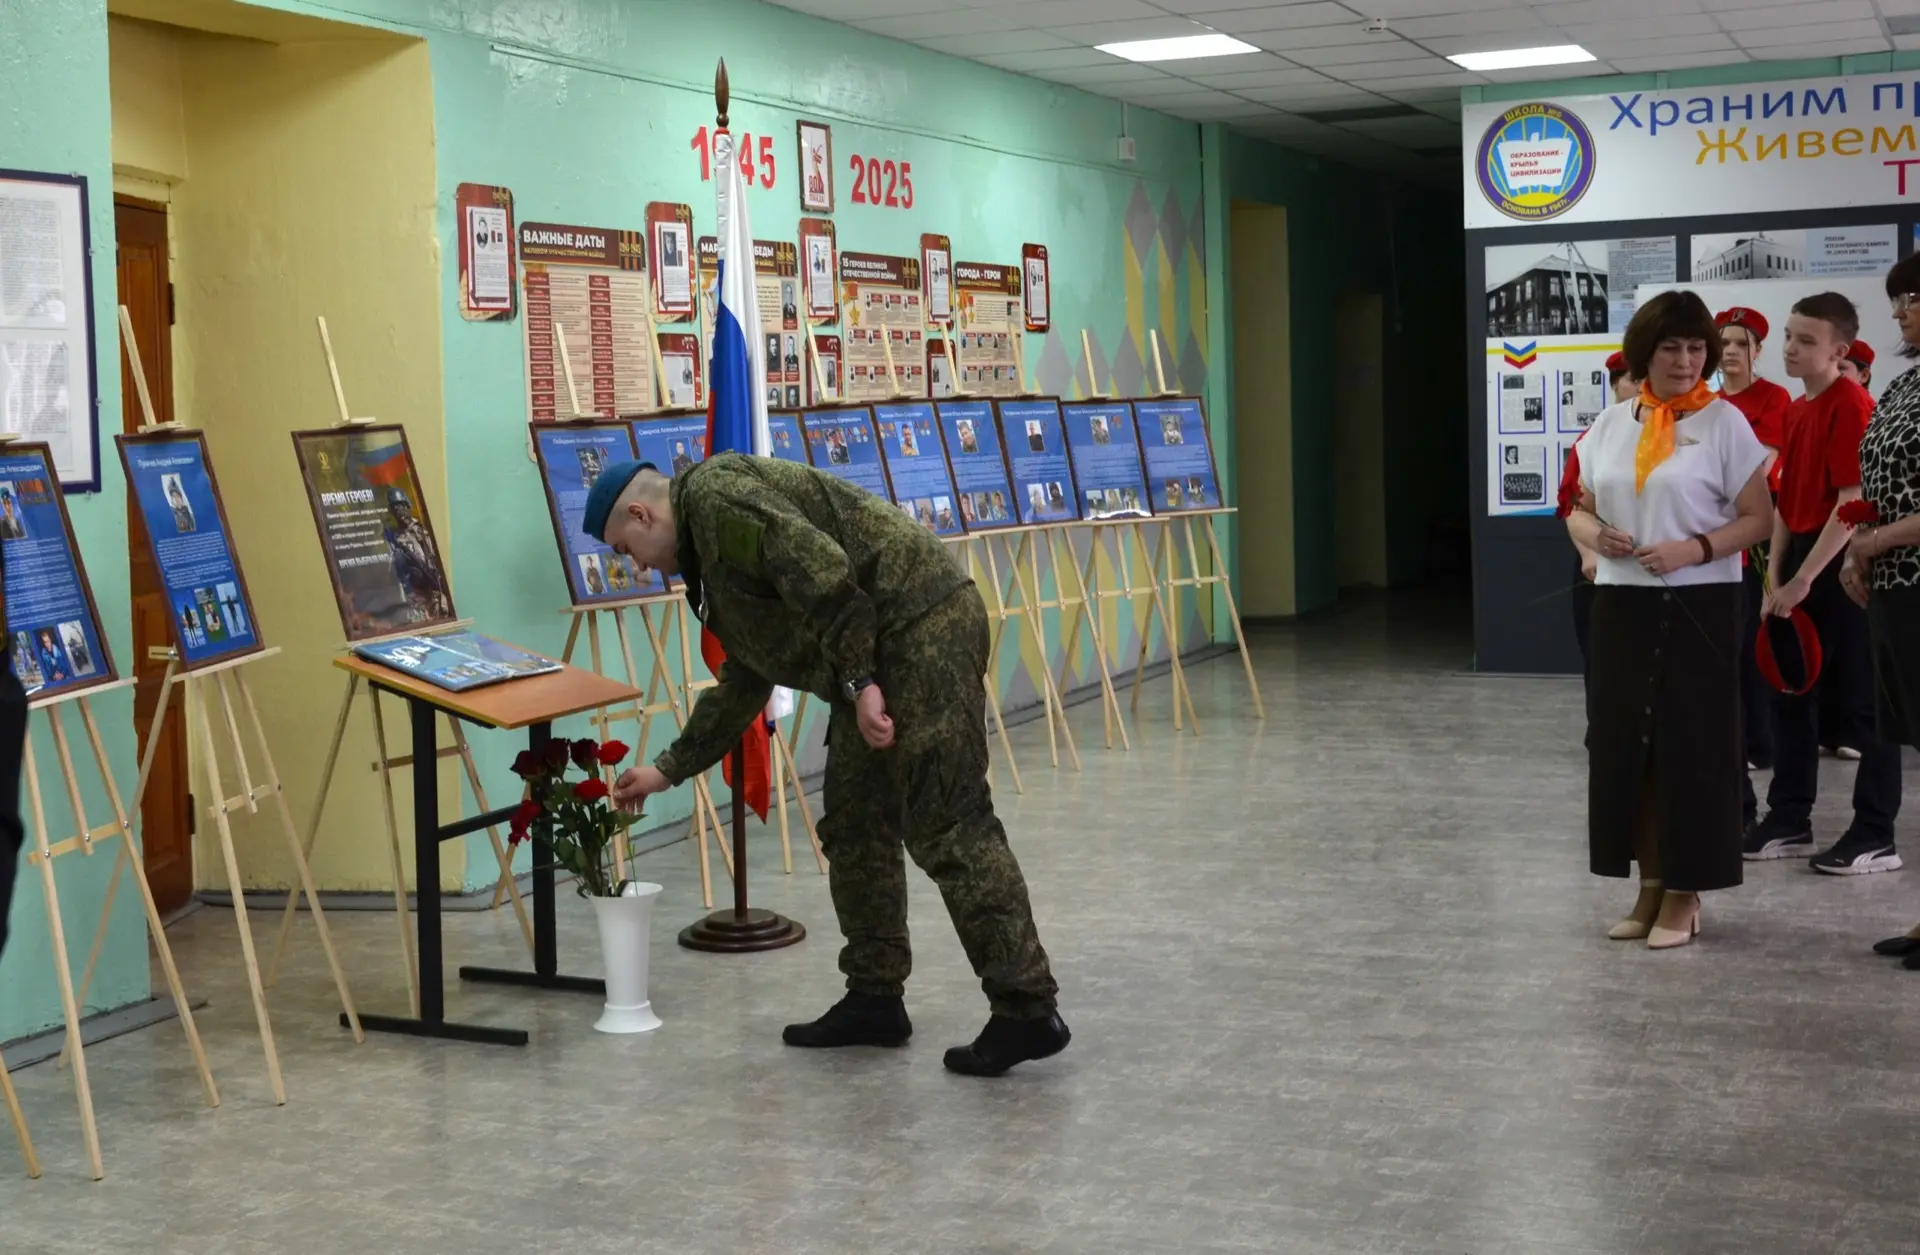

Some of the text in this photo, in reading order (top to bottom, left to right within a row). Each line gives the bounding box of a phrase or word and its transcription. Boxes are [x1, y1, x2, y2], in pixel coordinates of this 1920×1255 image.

[1504, 104, 1545, 122] ШКОЛА
[1608, 86, 1847, 136] Храним
[1694, 124, 1917, 165] Живем
[690, 126, 776, 191] 145
[1510, 149, 1559, 159] ОБРАЗОВАНИЕ
[1510, 168, 1562, 178] ЦИВИЛИЗАЦИИ
[850, 154, 914, 209] 2025
[1501, 200, 1541, 216] ОСНОВАНА
[523, 229, 606, 249] ВАЖНЫЕ ДАТЫ
[754, 246, 774, 258] БЕДЫ
[842, 256, 849, 267] 15
[849, 259, 866, 269] ГЕРОЕВ
[880, 271, 897, 280] ВОЙНЫ
[956, 267, 980, 280] ГОРОДА
[984, 269, 1001, 280] ГЕРОИ
[321, 491, 347, 507] ВРЕМЯ
